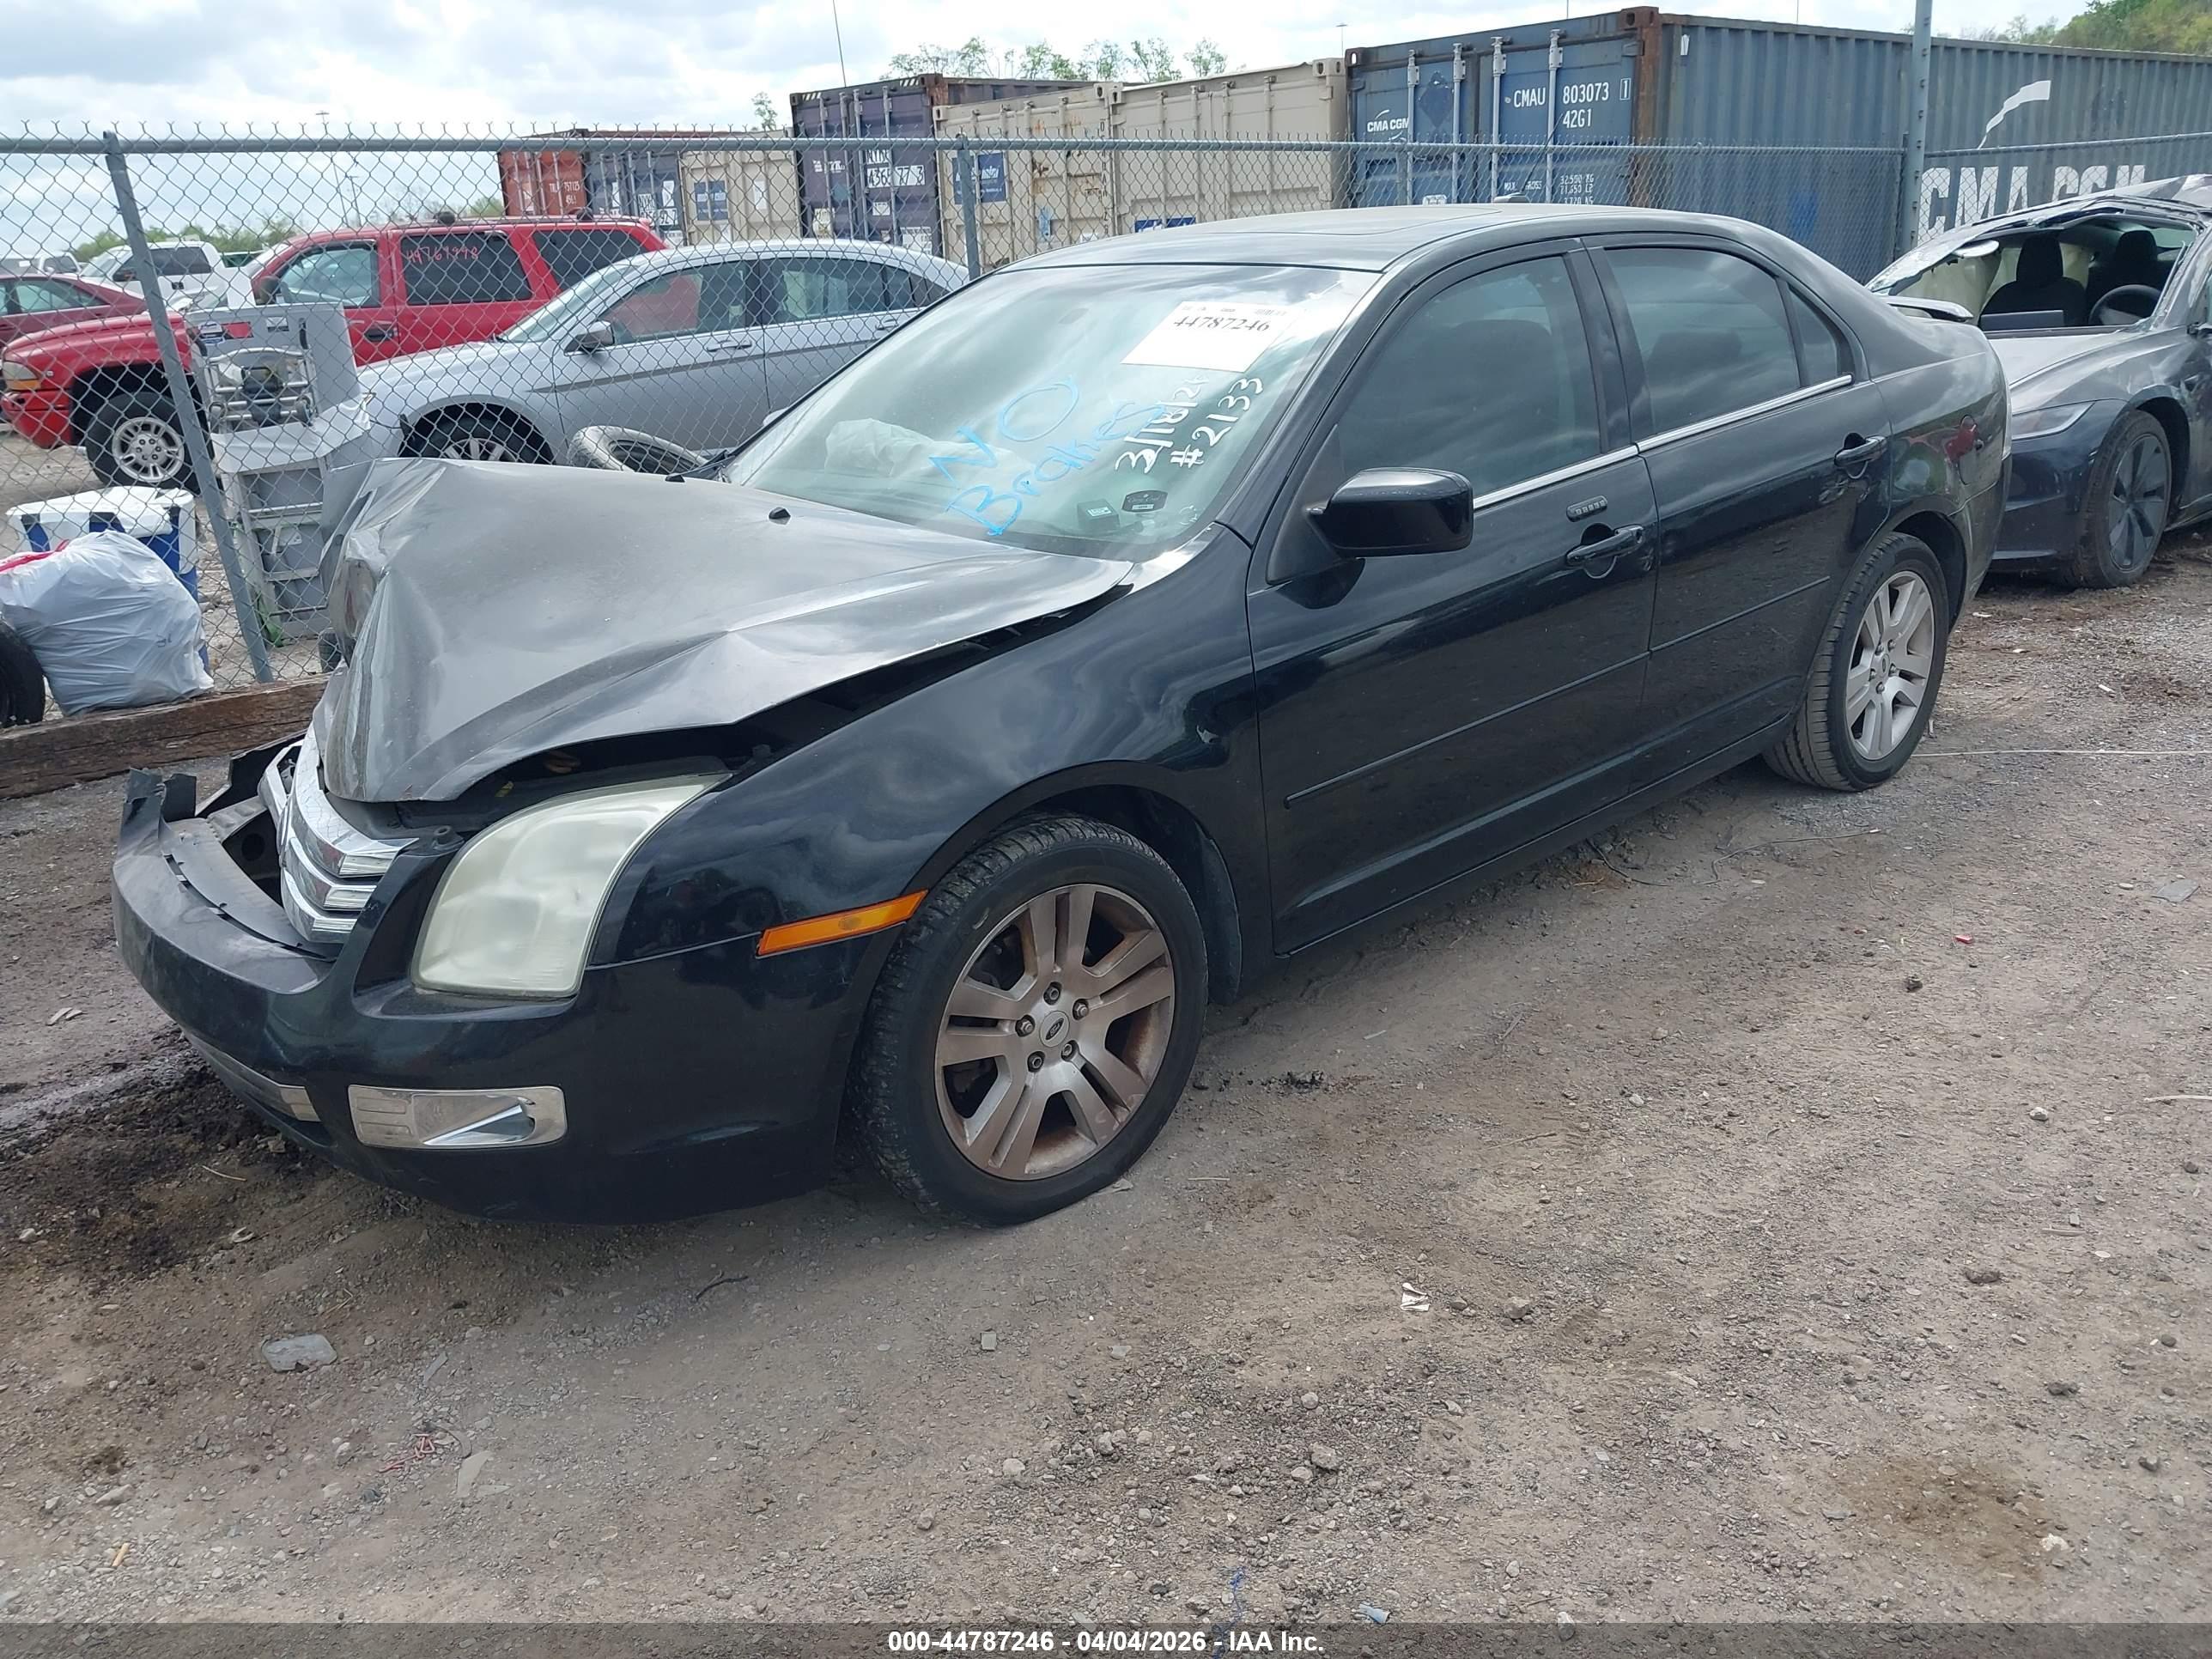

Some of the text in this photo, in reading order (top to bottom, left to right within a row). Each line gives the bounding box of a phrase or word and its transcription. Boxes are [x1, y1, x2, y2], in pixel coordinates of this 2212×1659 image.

[1513, 88, 1547, 108] CMAU
[1563, 82, 1610, 104] 803073
[1367, 117, 1409, 132] CMA CGM
[1562, 108, 1593, 129] 42G1
[1918, 166, 2028, 246] CMA
[1173, 315, 1271, 331] 44787246
[927, 379, 1080, 489] NO
[1170, 377, 1264, 469] #2133
